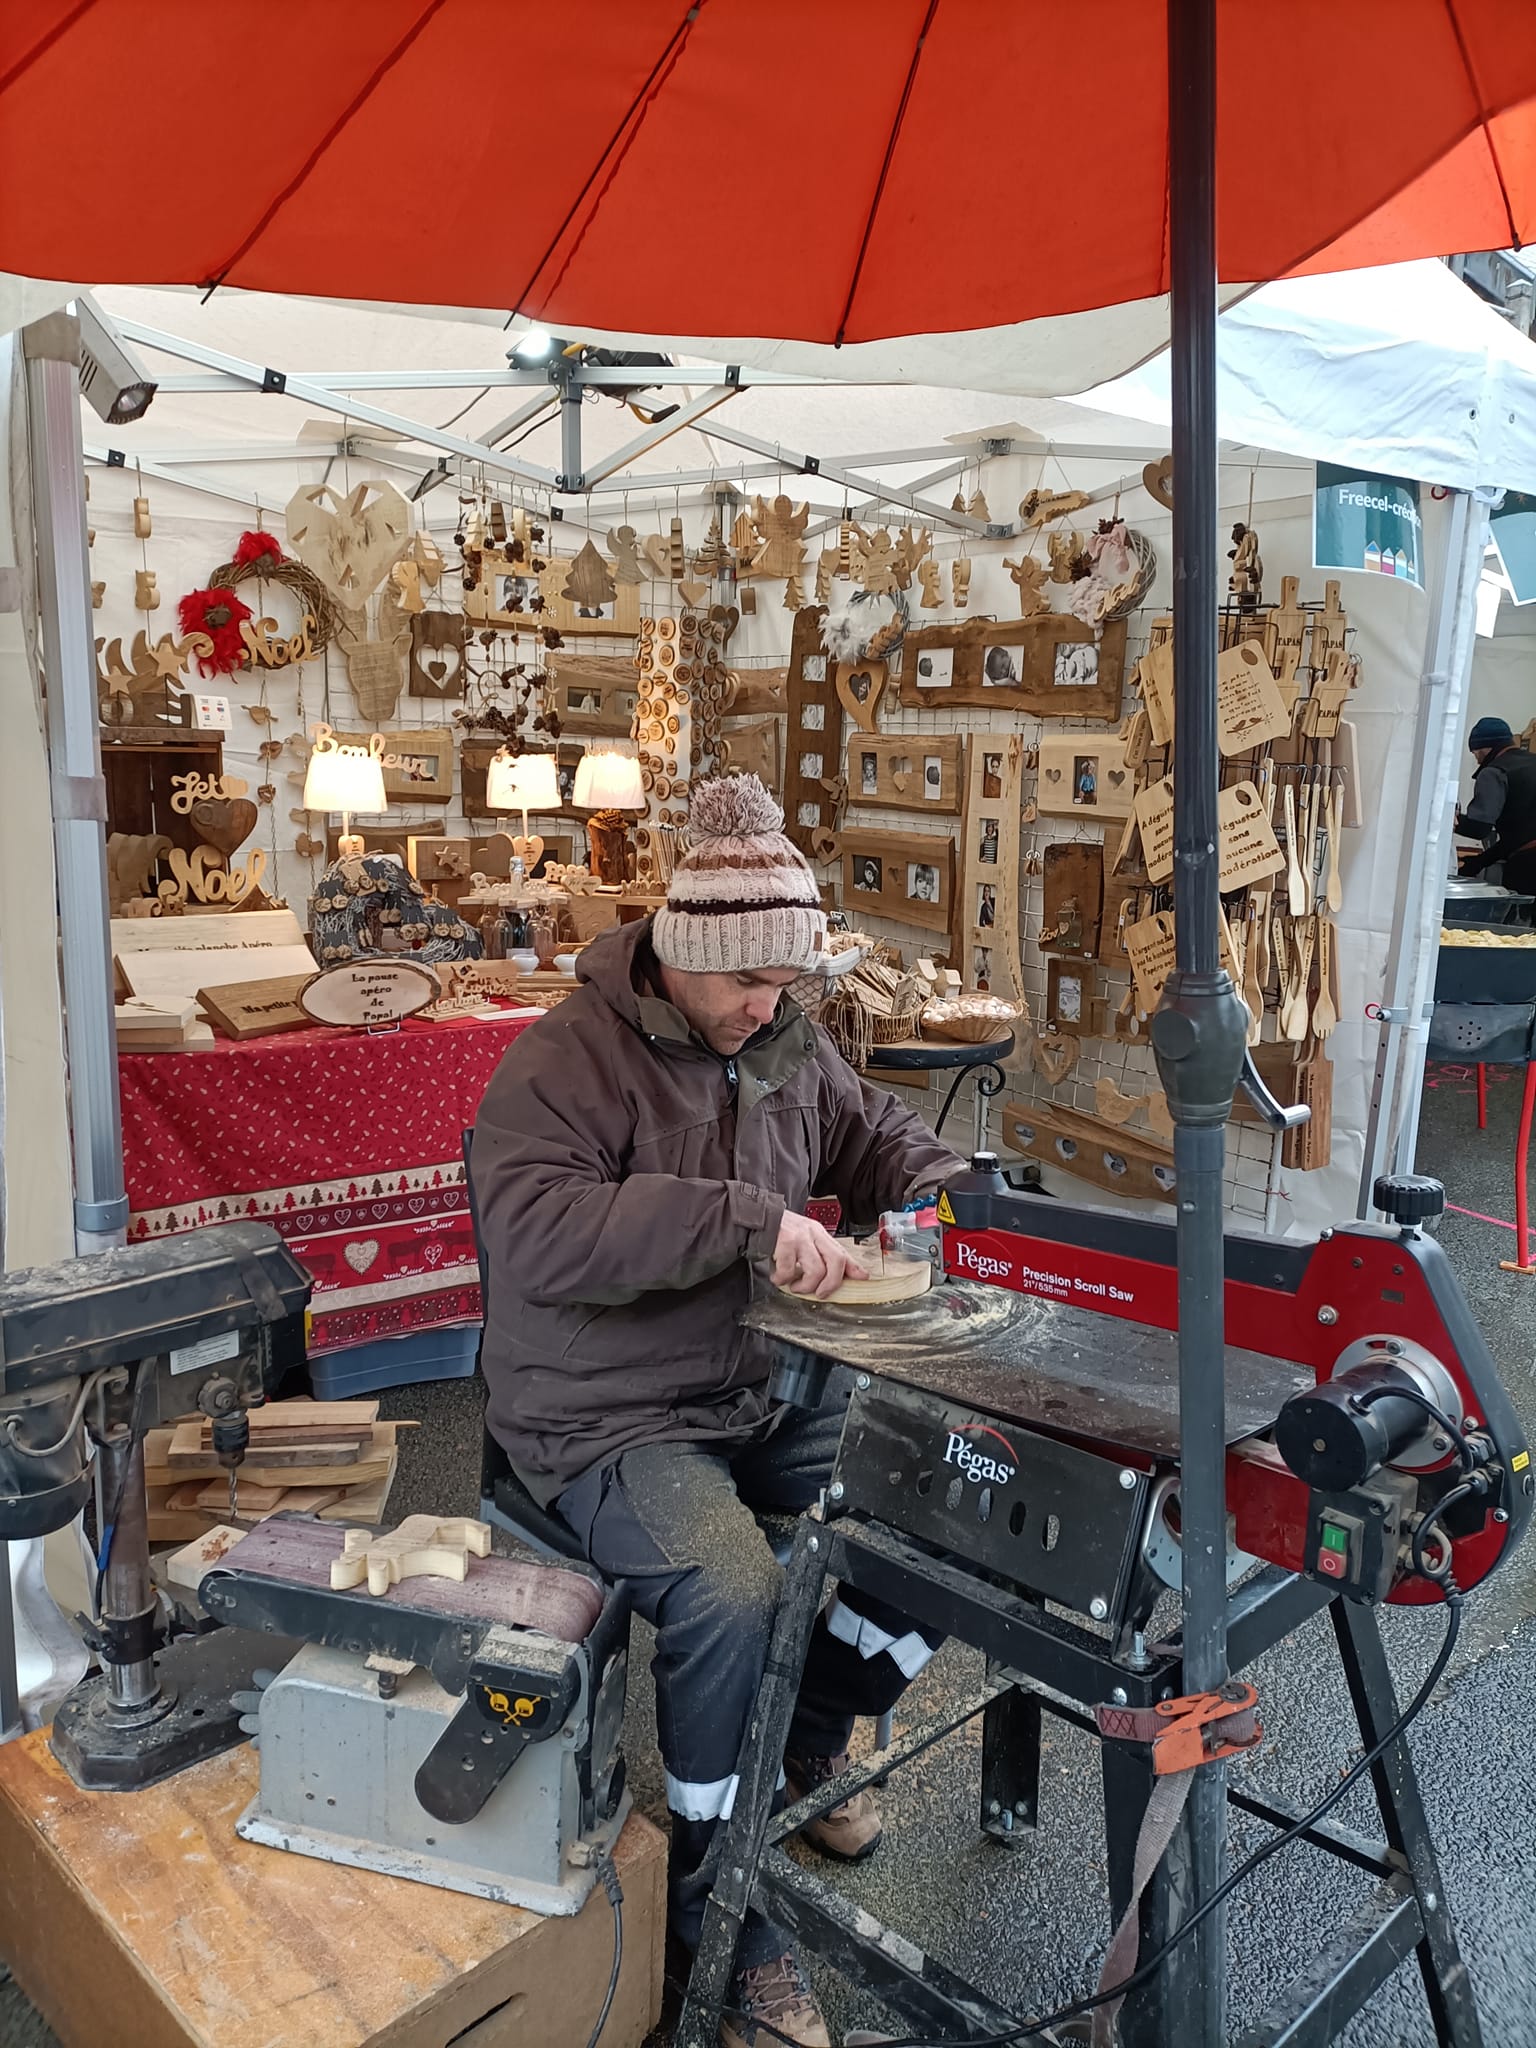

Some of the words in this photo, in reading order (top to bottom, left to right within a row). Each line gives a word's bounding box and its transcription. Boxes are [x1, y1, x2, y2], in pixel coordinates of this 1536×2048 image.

[1278, 636, 1301, 646] TAPAS
[1321, 640, 1343, 649] TAPAS
[1228, 830, 1250, 844] sans
[1225, 839, 1264, 860] aucune
[158, 847, 272, 904] Noel
[352, 973, 366, 983] La
[367, 974, 399, 984] pause
[360, 985, 392, 997] apéro
[370, 997, 384, 1007] de
[1022, 1266, 1072, 1288] Precision
[1074, 1278, 1106, 1296] Scroll
[1108, 1286, 1135, 1303] Saw
